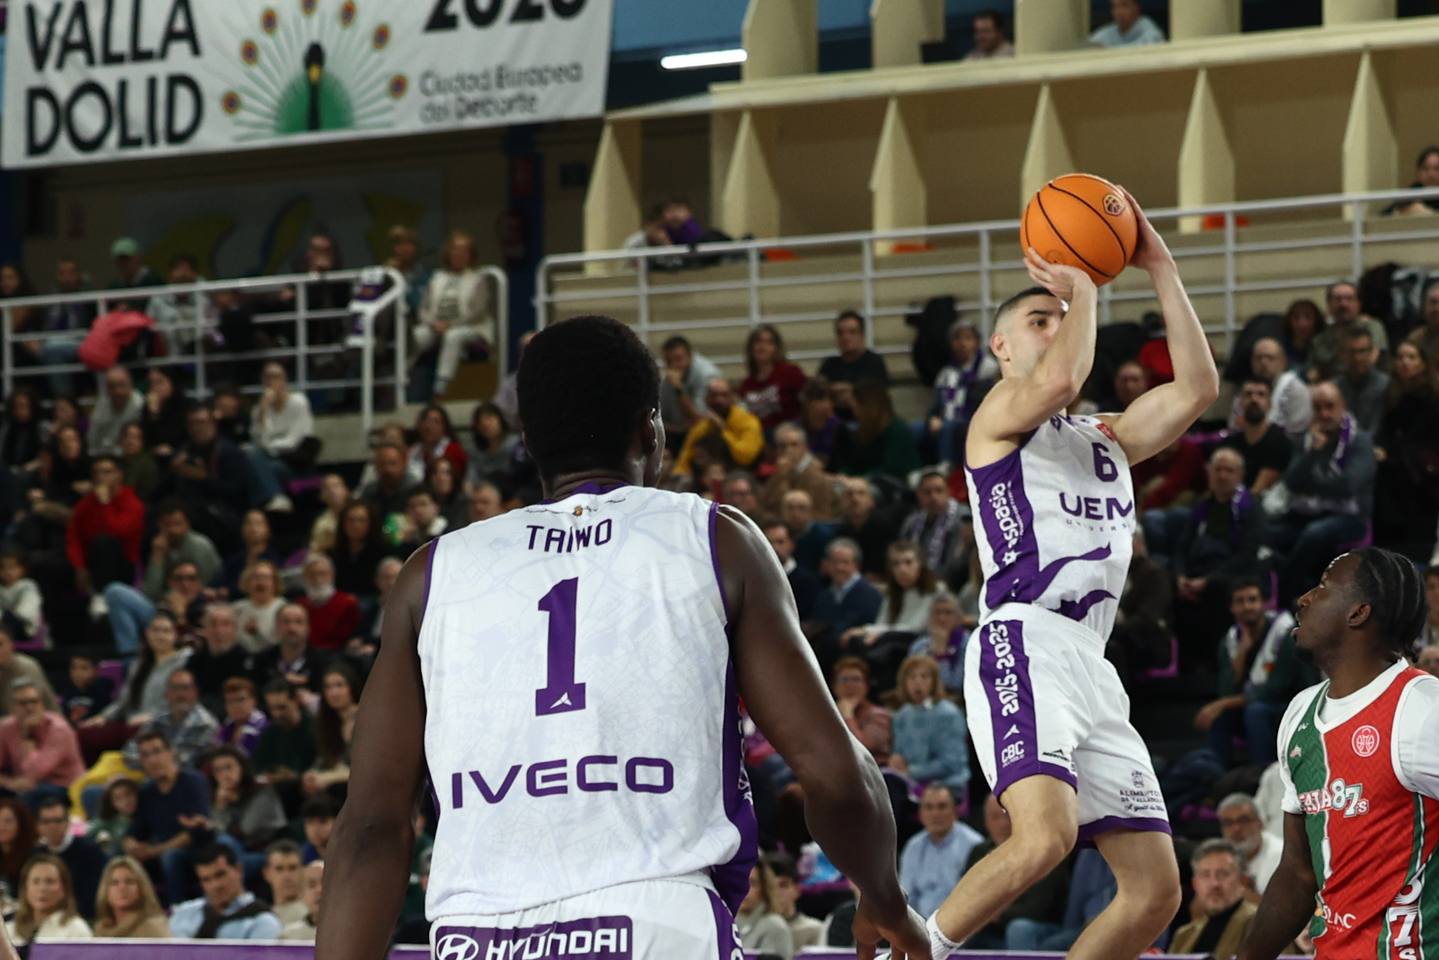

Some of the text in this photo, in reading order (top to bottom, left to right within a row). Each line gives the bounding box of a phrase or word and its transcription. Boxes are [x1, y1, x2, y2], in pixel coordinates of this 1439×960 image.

[25, 0, 201, 71] VALLA
[26, 74, 205, 157] DOLID
[1091, 442, 1119, 482] 6
[526, 518, 613, 554] TAIWO
[535, 576, 587, 717] 1
[451, 755, 674, 809] IVECO
